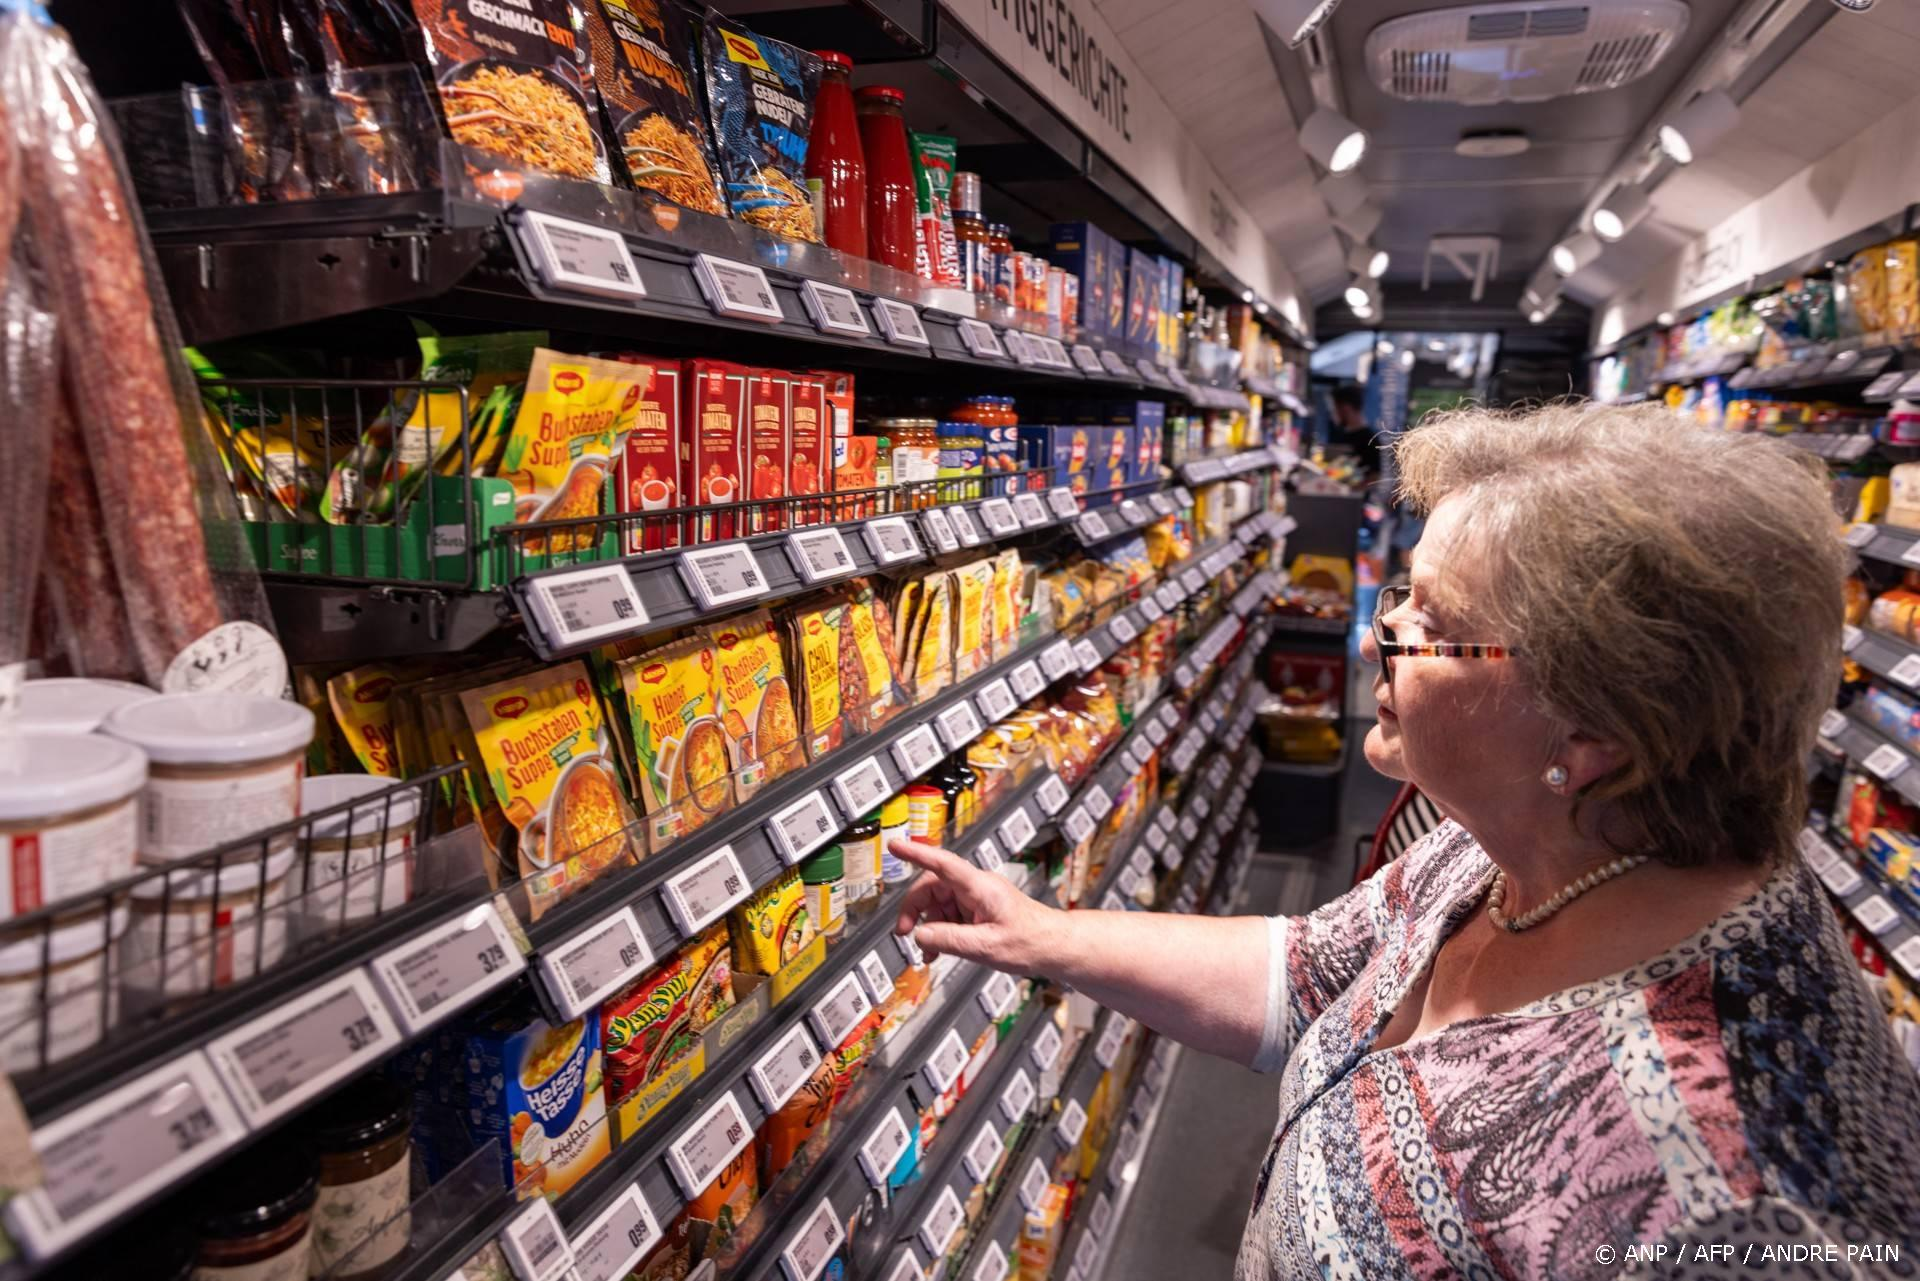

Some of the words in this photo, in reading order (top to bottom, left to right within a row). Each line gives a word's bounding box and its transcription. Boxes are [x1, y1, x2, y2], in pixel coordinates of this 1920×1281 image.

[499, 709, 582, 766] Buchstaben
[506, 753, 553, 790] Suppe
[527, 1046, 586, 1111] Heisse
[535, 1069, 582, 1122] Tasse
[628, 1218, 648, 1249] 0.99
